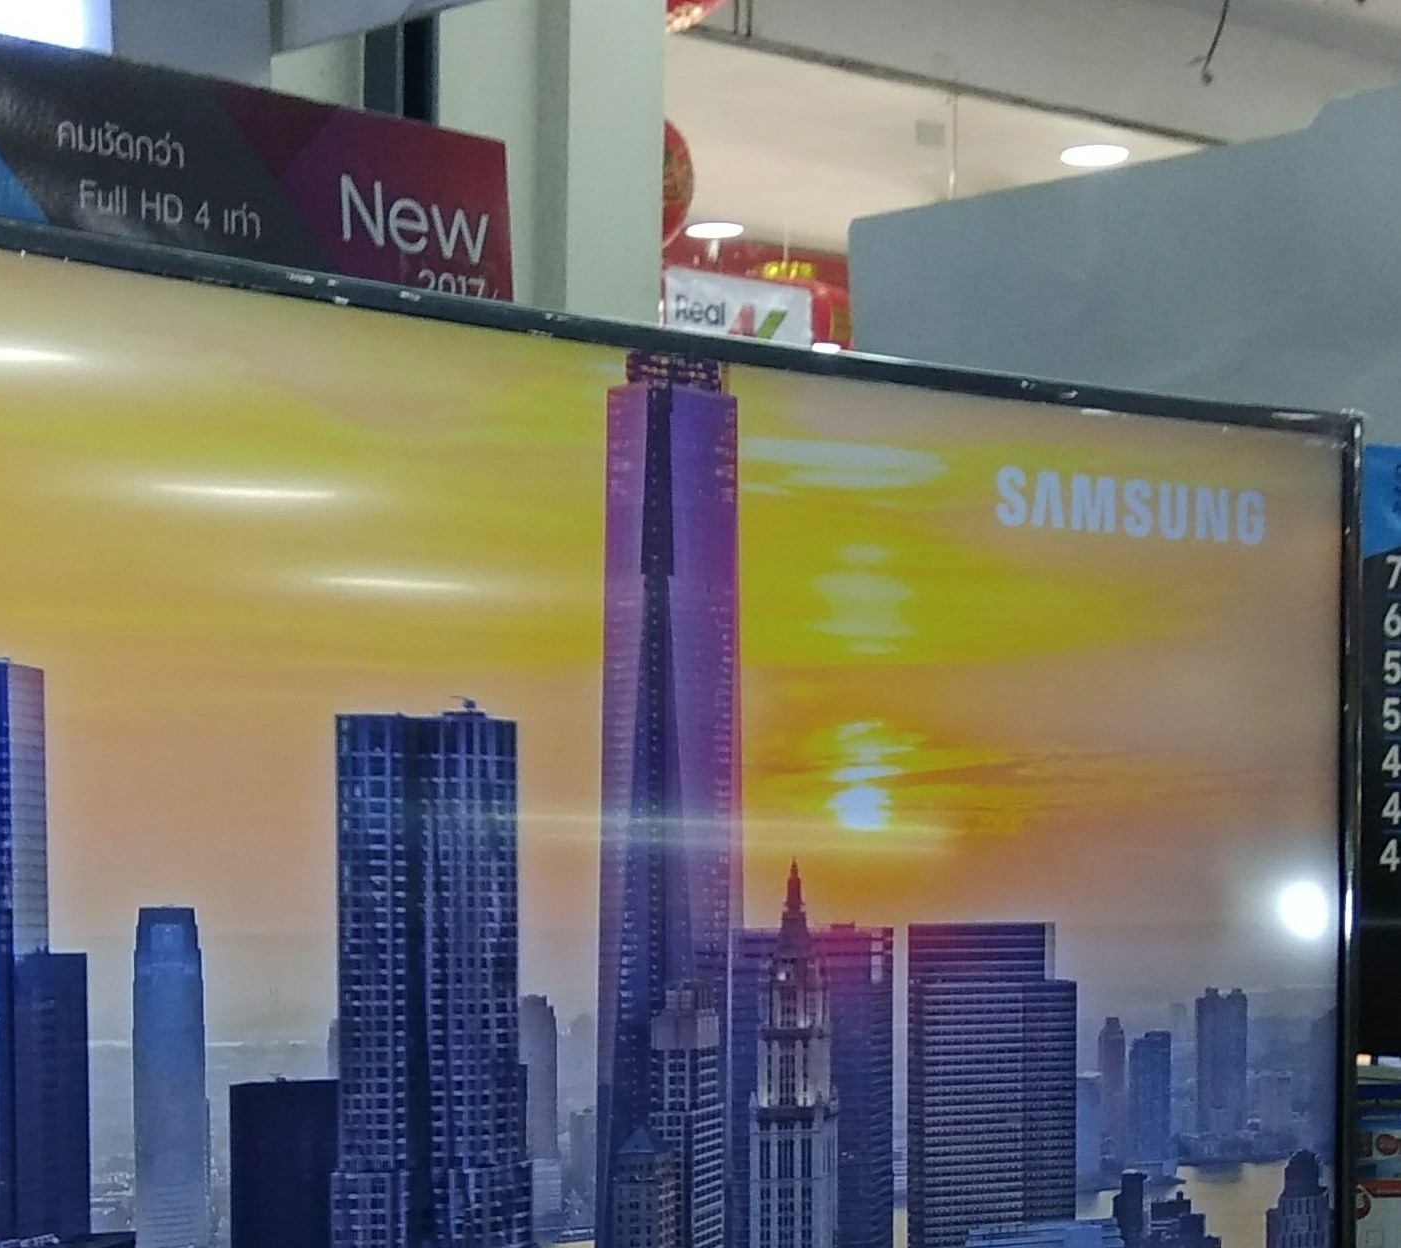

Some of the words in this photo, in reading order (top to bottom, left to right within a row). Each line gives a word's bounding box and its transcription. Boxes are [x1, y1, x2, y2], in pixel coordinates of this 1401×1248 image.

[56, 119, 186, 170] คมชัดกว่า
[78, 178, 127, 217] Full
[140, 187, 184, 226] HD
[194, 200, 211, 232] 4
[339, 172, 490, 267] New
[995, 464, 1266, 546] SAMSUNG
